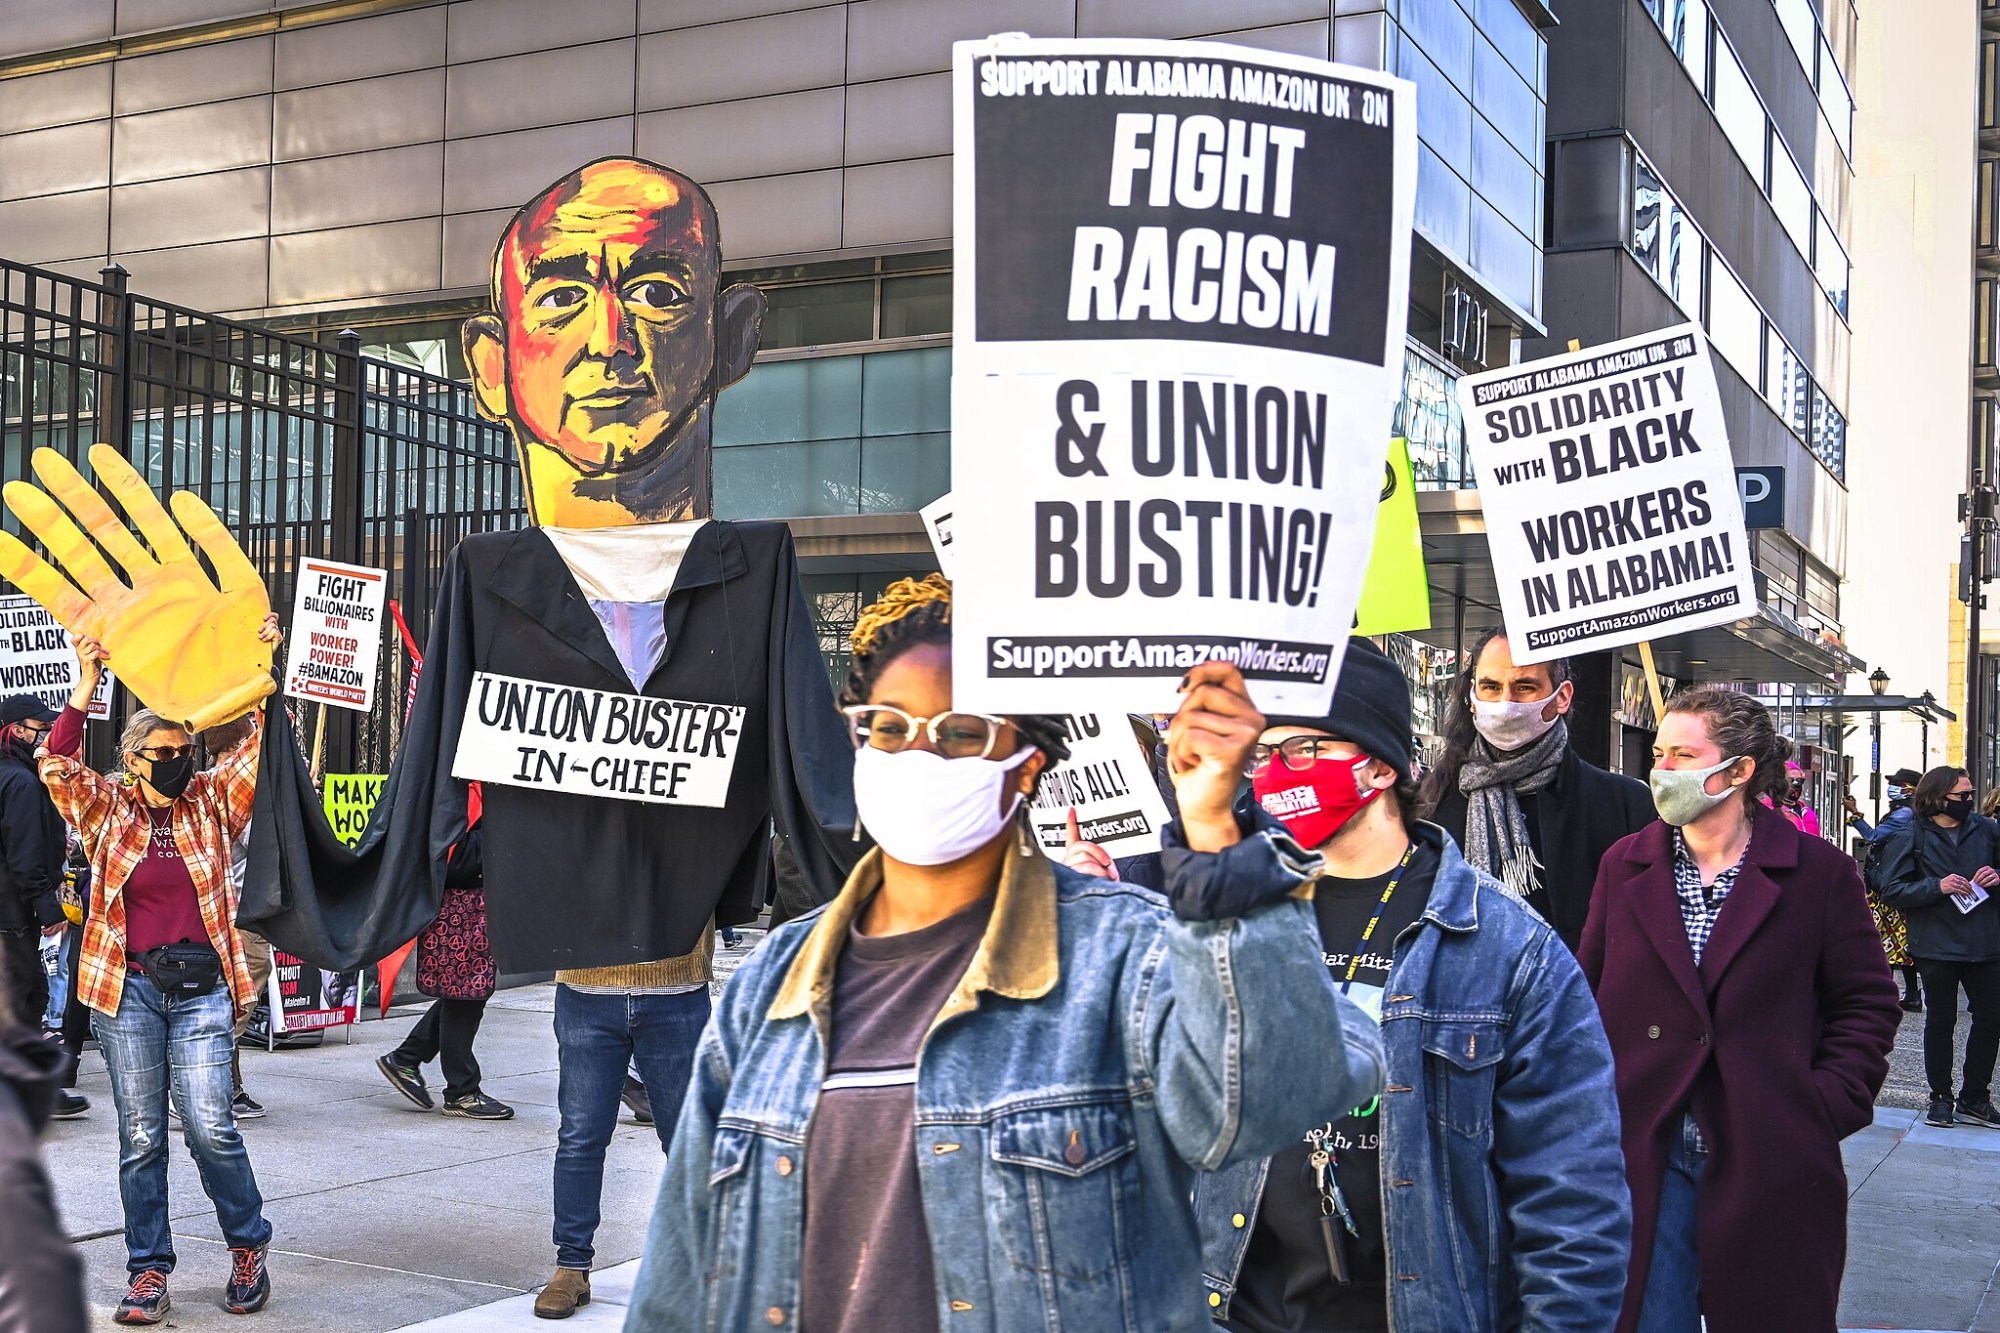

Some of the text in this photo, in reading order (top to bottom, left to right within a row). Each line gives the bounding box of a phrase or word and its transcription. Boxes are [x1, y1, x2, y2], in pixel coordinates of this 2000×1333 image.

[980, 61, 1100, 97] SUPPORT
[1105, 60, 1226, 100] ALABAMA
[1229, 67, 1318, 114] AMAZON
[1108, 113, 1306, 218] FIGHT
[1067, 226, 1336, 337] RACISM
[1477, 378, 1534, 404] SUPPORT
[1535, 360, 1596, 392] ALABAMA
[1597, 348, 1650, 378] AMAZON
[1485, 366, 1686, 444] SOLIDARITY
[1055, 379, 1109, 478] &
[1131, 379, 1328, 490] UNION
[1494, 408, 1702, 486] WITH BLACK
[1521, 480, 1712, 563] WORKERS
[1739, 473, 1771, 523] P
[1034, 498, 1333, 608] BUSTING!
[1521, 532, 1735, 618] IN ALABAMA!
[304, 596, 374, 622] BILLIONAIRES
[317, 574, 366, 602] FIGHT
[11, 628, 67, 653] BLACK
[310, 631, 358, 653] WORKER
[325, 615, 349, 631] WITH
[0, 662, 71, 689] WORKERS
[298, 661, 363, 687] #BAMAZON
[309, 649, 354, 668] POWER!
[478, 678, 603, 743] UNION
[513, 747, 690, 798] IN-CHIEF
[1084, 759, 1130, 802] ALL!
[284, 996, 306, 1008] Malcolm
